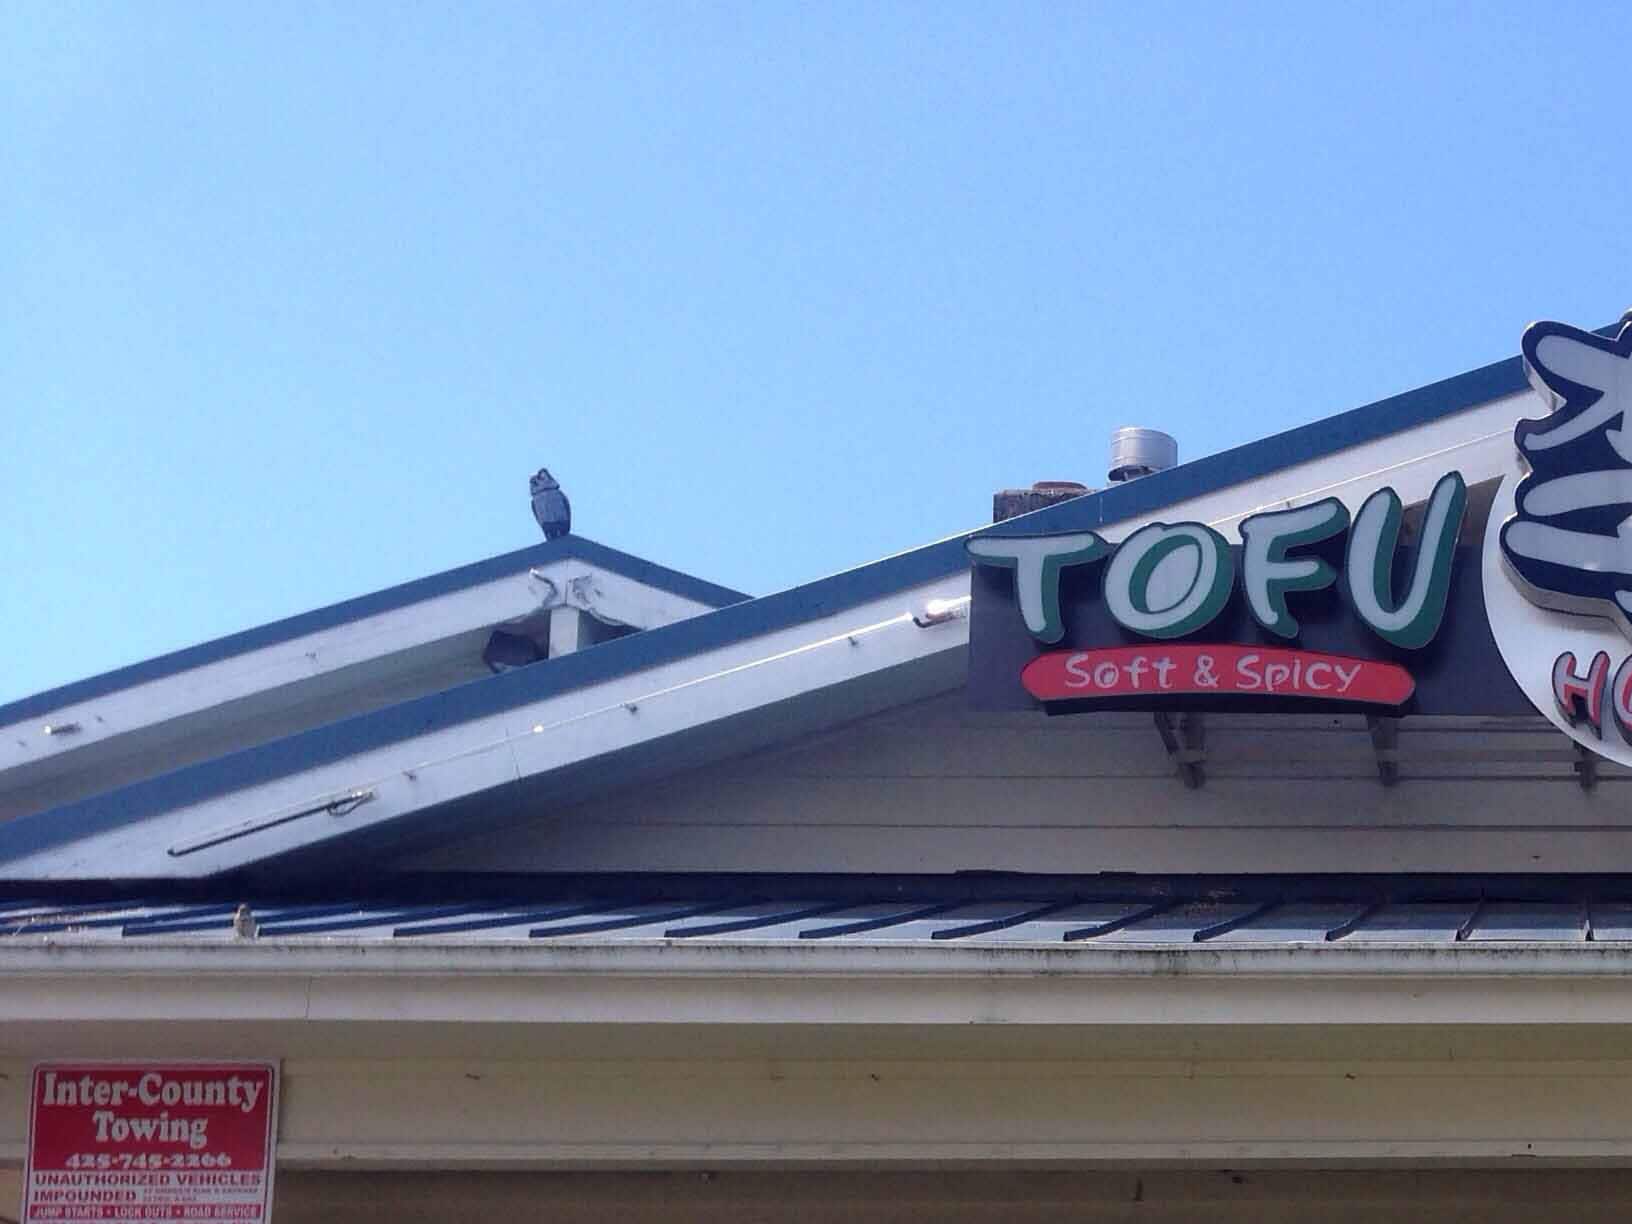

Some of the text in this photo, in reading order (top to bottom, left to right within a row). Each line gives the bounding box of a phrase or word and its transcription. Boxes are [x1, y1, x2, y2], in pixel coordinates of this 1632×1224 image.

[964, 470, 1467, 649] TOFU
[1064, 653, 1175, 690] Soft
[1194, 655, 1219, 688] &
[43, 1073, 263, 1112] Inter-County
[92, 1110, 208, 1149] Towing
[34, 1189, 137, 1202] IMPOUNDED
[35, 1173, 261, 1186] UNAUTHORIZED VEHICLES
